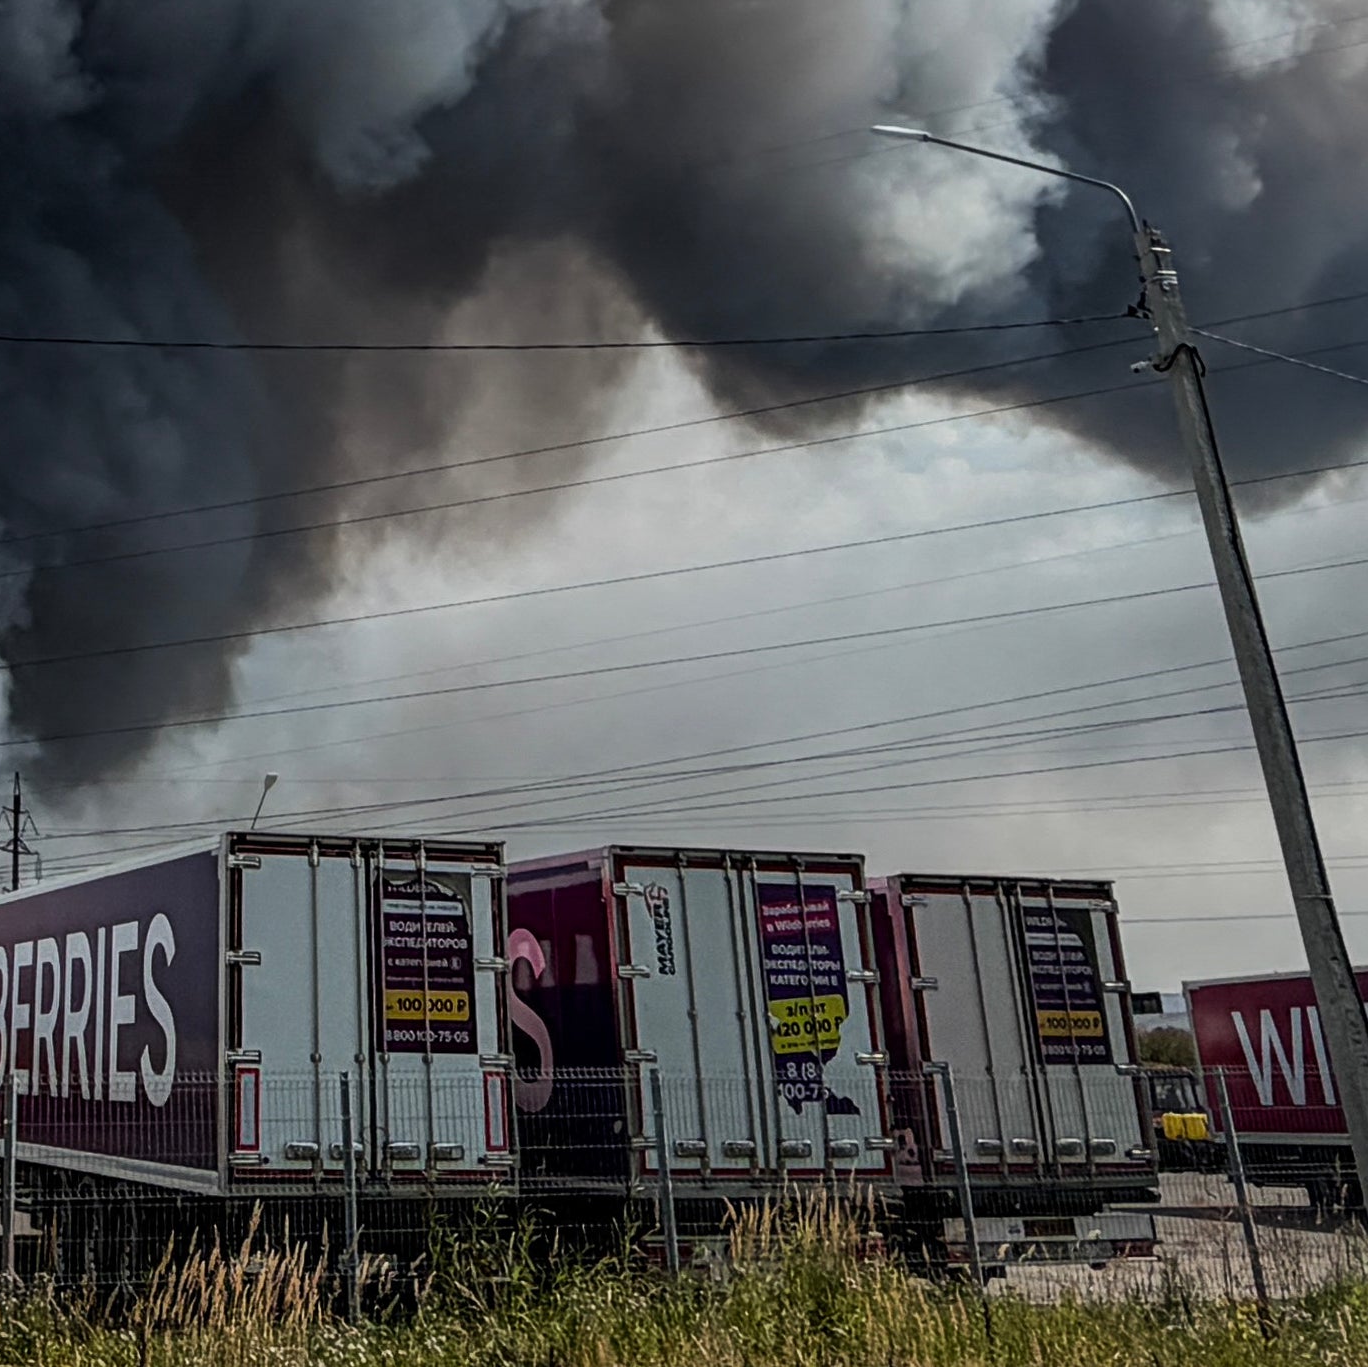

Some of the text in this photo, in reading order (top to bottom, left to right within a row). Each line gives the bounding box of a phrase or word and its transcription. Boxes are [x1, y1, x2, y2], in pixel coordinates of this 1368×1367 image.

[397, 998, 422, 1012] 100
[1046, 1017, 1066, 1030] 100
[786, 1062, 797, 1078] 8
